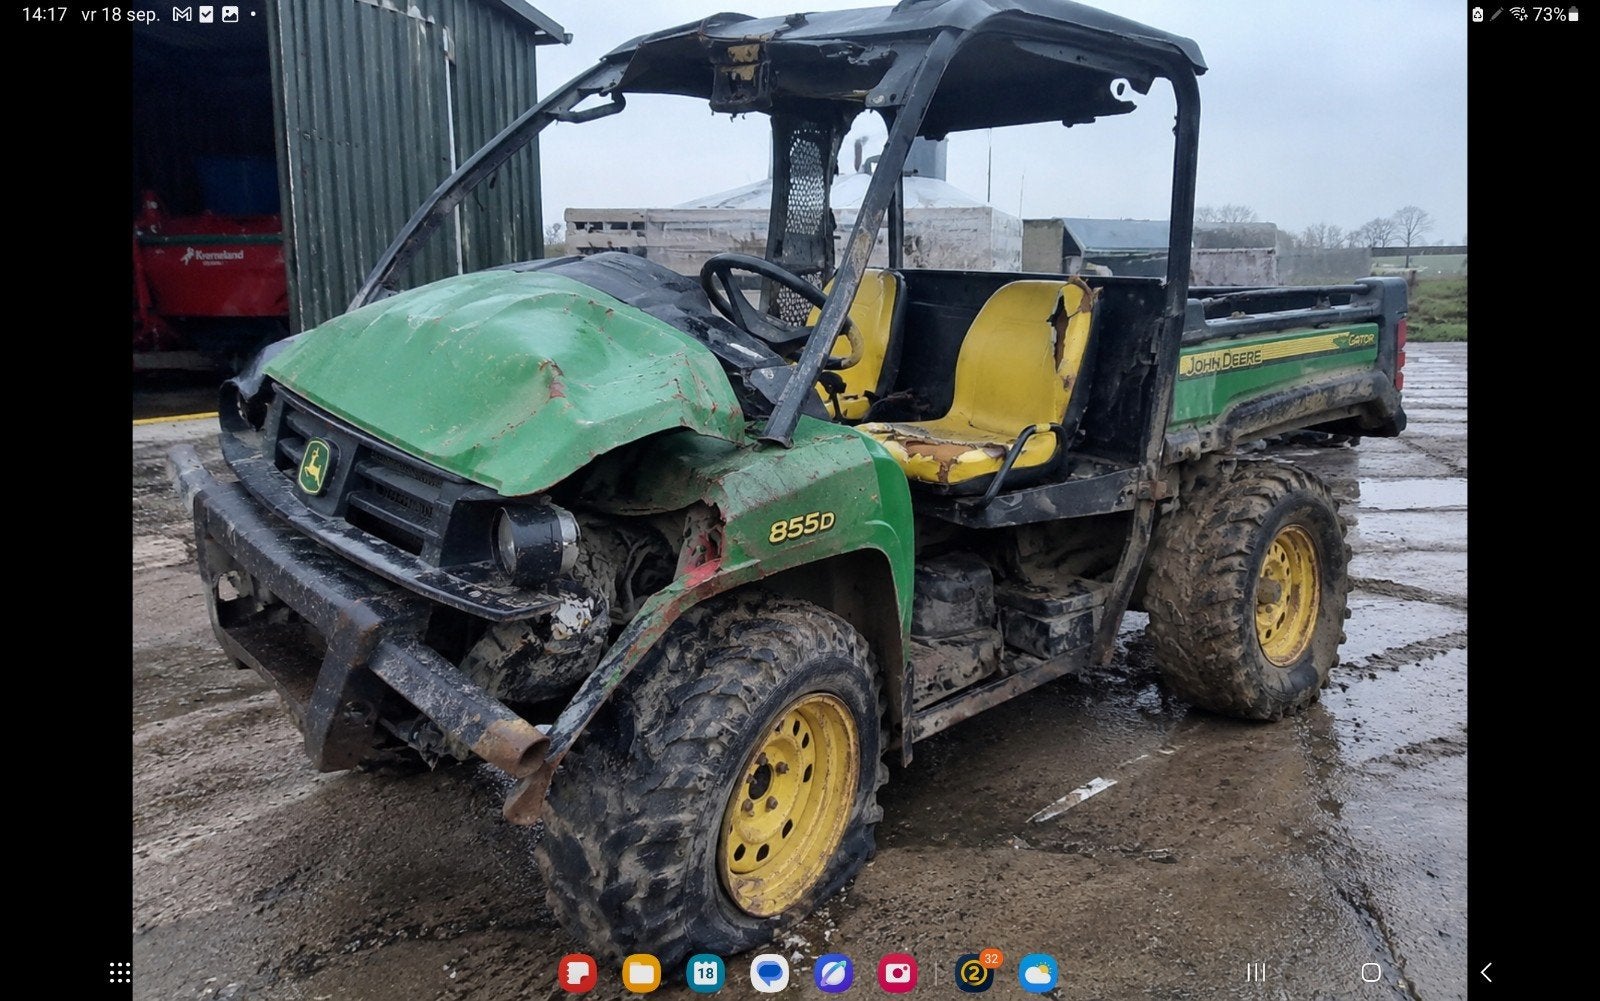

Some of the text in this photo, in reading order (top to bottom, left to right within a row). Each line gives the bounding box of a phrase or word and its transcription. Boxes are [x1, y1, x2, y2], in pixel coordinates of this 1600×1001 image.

[1349, 334, 1375, 346] GATOR
[1187, 350, 1262, 374] JOHN DEERE
[768, 511, 835, 544] 855D
